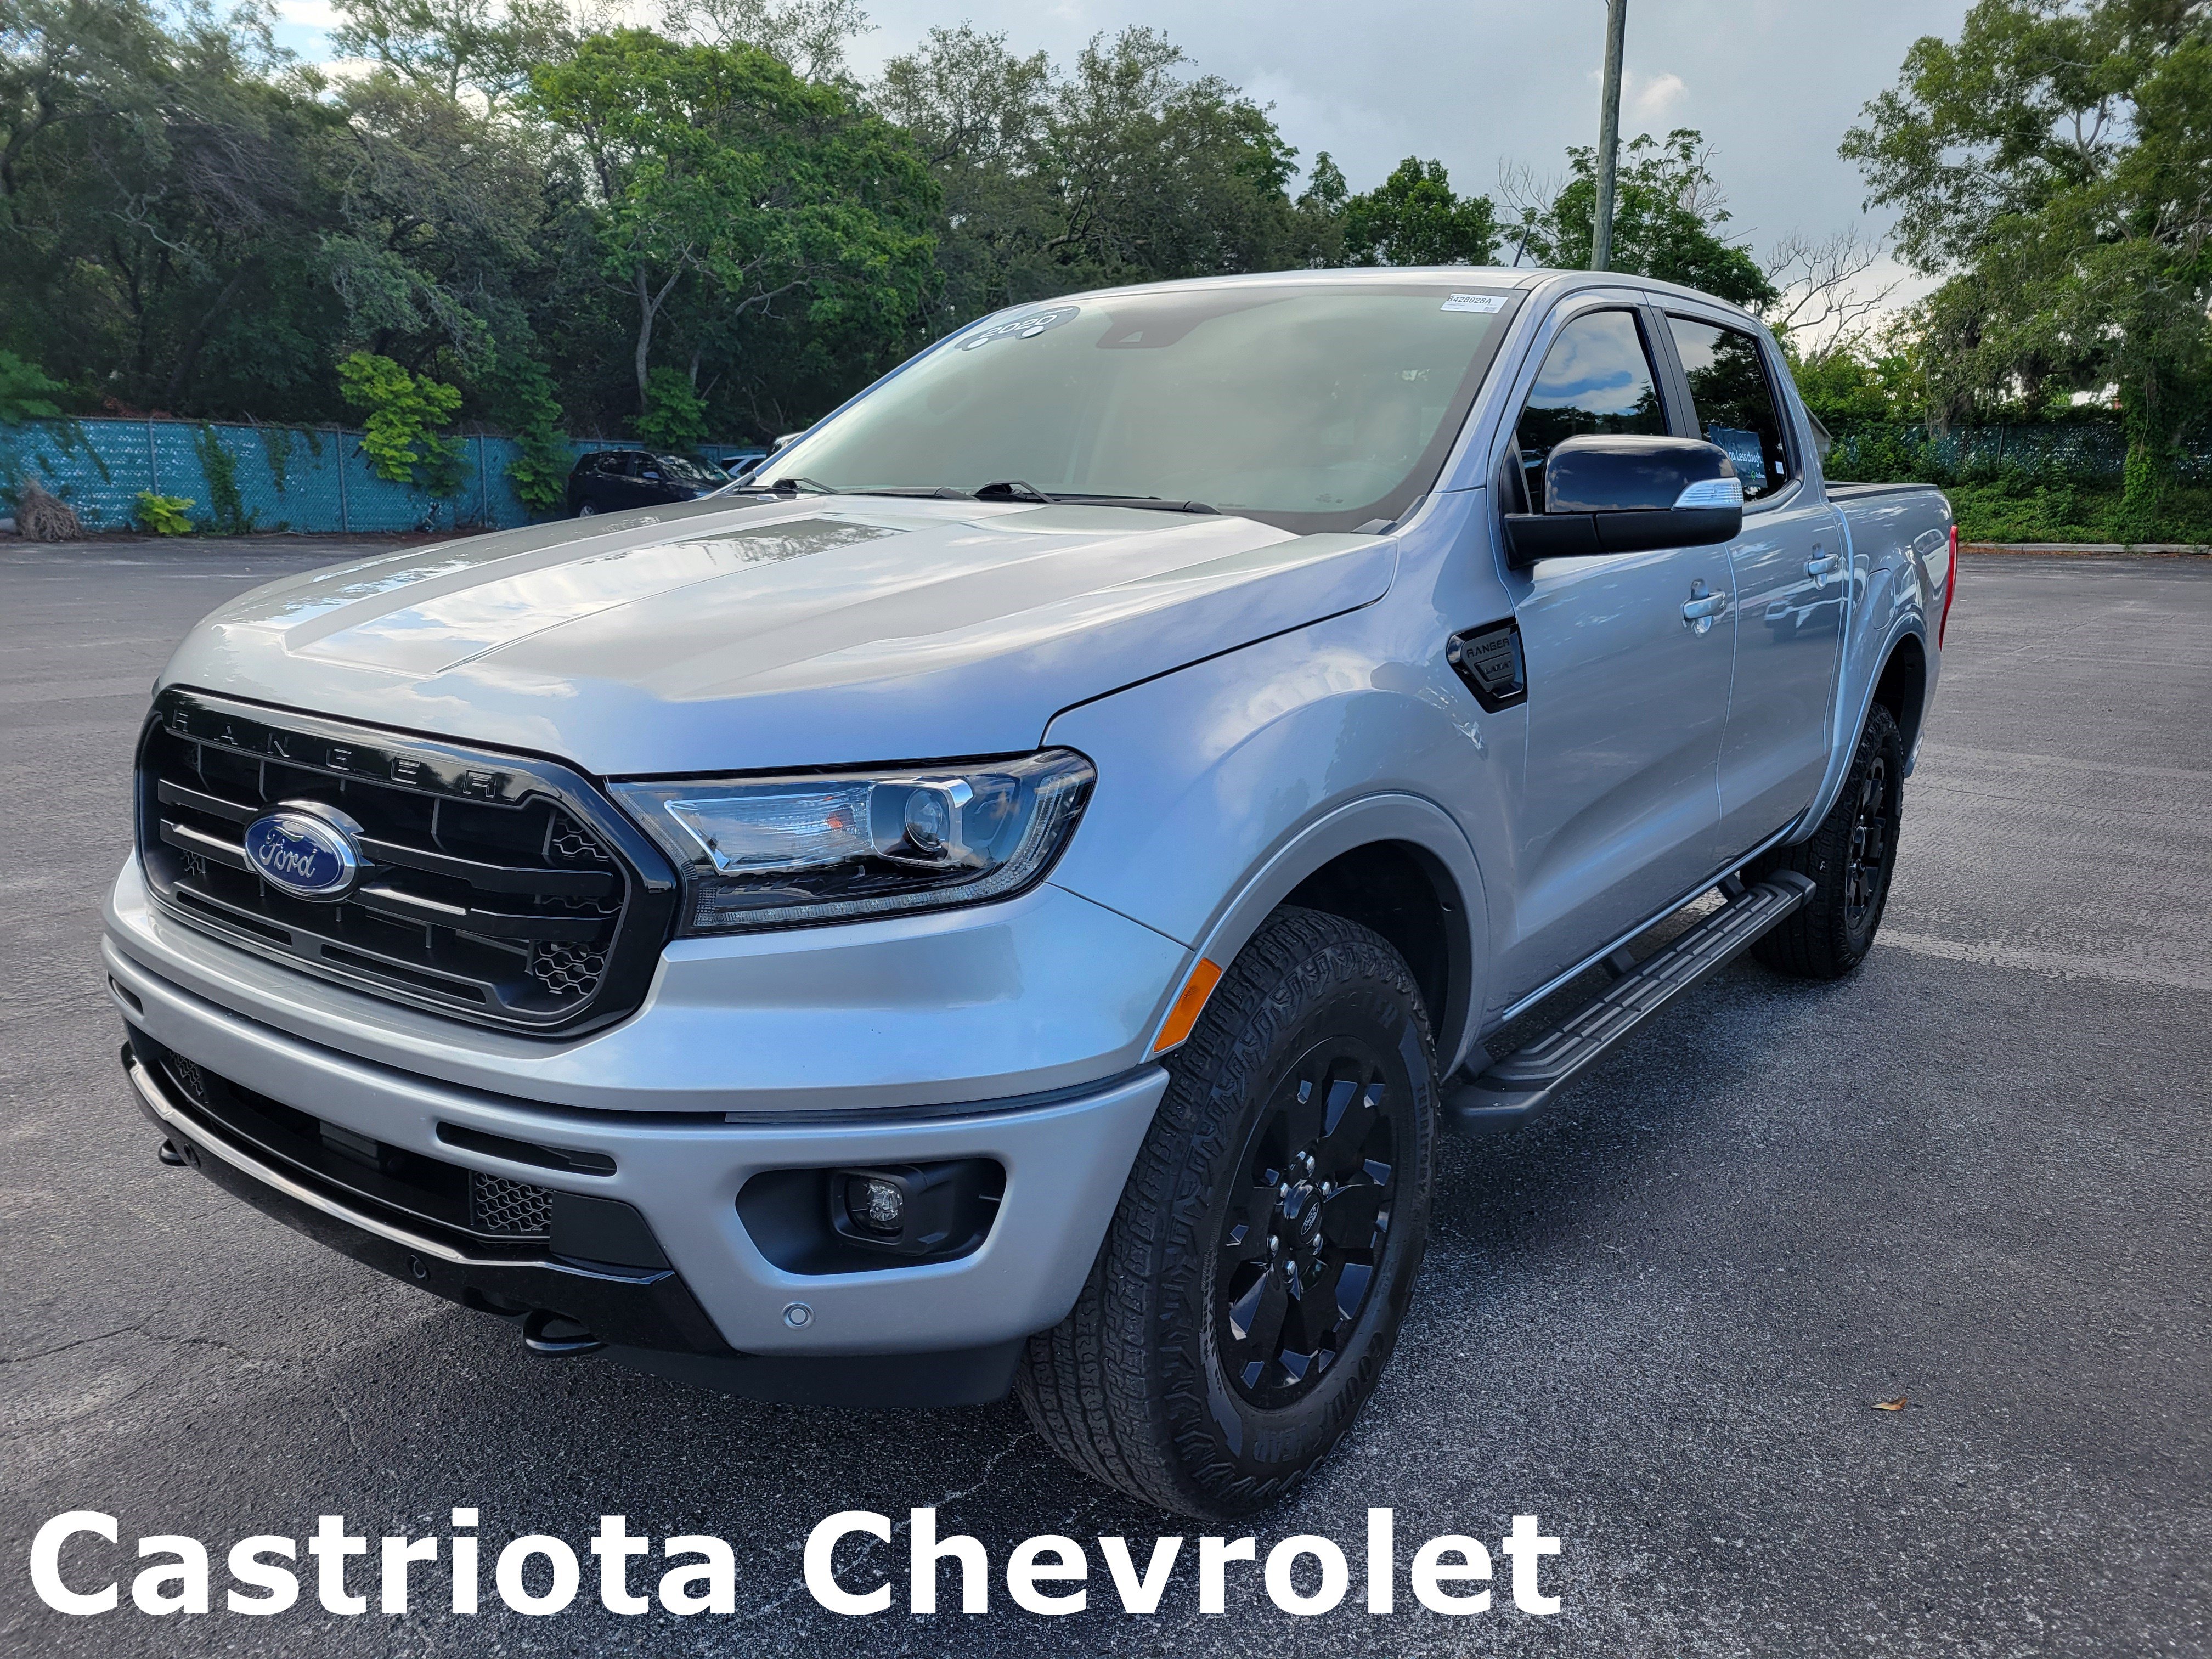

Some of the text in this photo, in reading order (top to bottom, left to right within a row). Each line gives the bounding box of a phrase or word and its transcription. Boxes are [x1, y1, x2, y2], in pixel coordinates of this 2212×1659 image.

[978, 314, 1058, 339] 2020
[1735, 449, 1747, 462] Less
[1747, 451, 1763, 467] dough.
[1466, 637, 1510, 658] RANGER
[171, 709, 496, 799] RANGER
[258, 825, 318, 879] Ford
